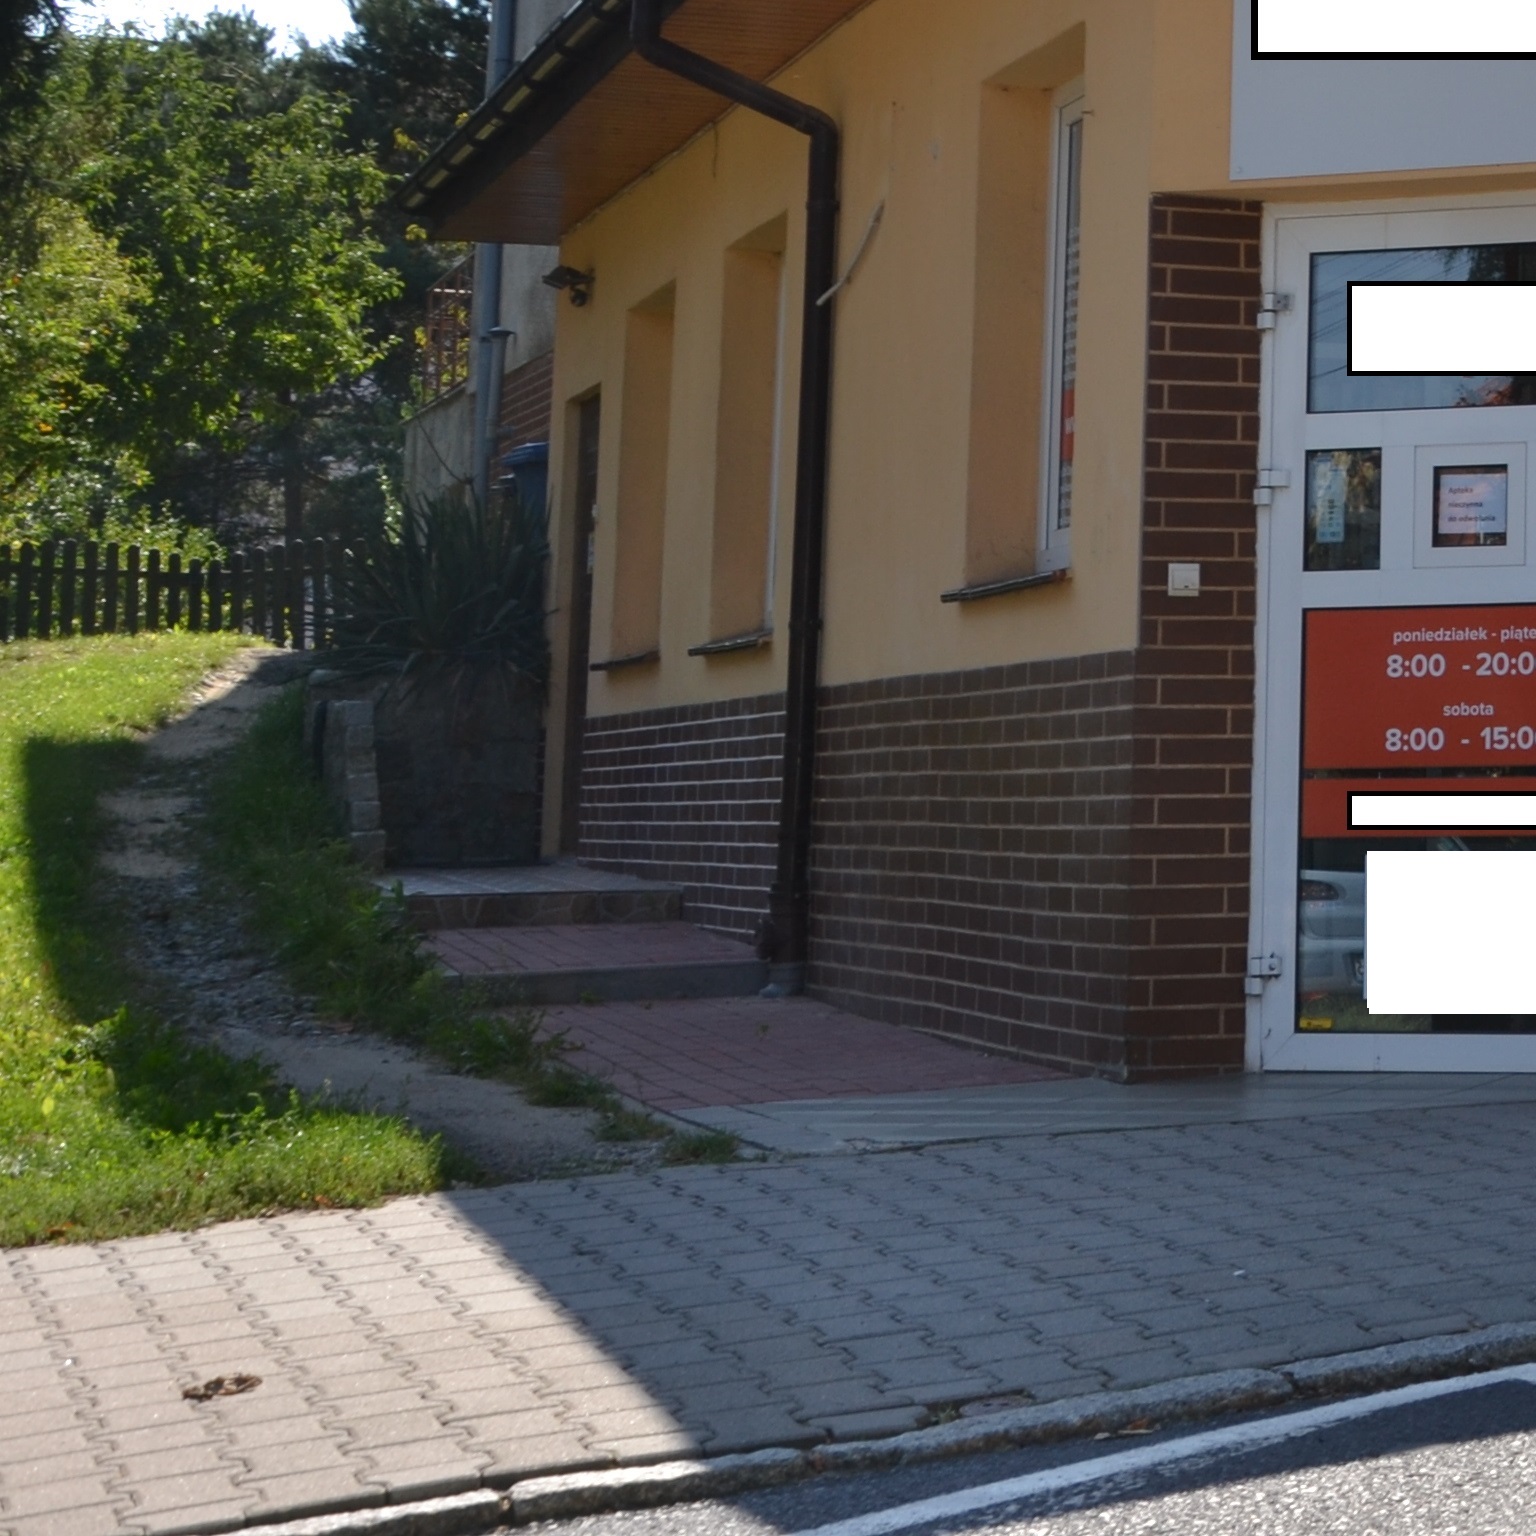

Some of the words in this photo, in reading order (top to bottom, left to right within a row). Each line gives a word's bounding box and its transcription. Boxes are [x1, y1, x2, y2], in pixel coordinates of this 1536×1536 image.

[1393, 627, 1488, 645] poniedziałek
[1386, 653, 1446, 678] 8:00
[1443, 702, 1494, 716] sobota
[1385, 727, 1445, 752] 8:00
